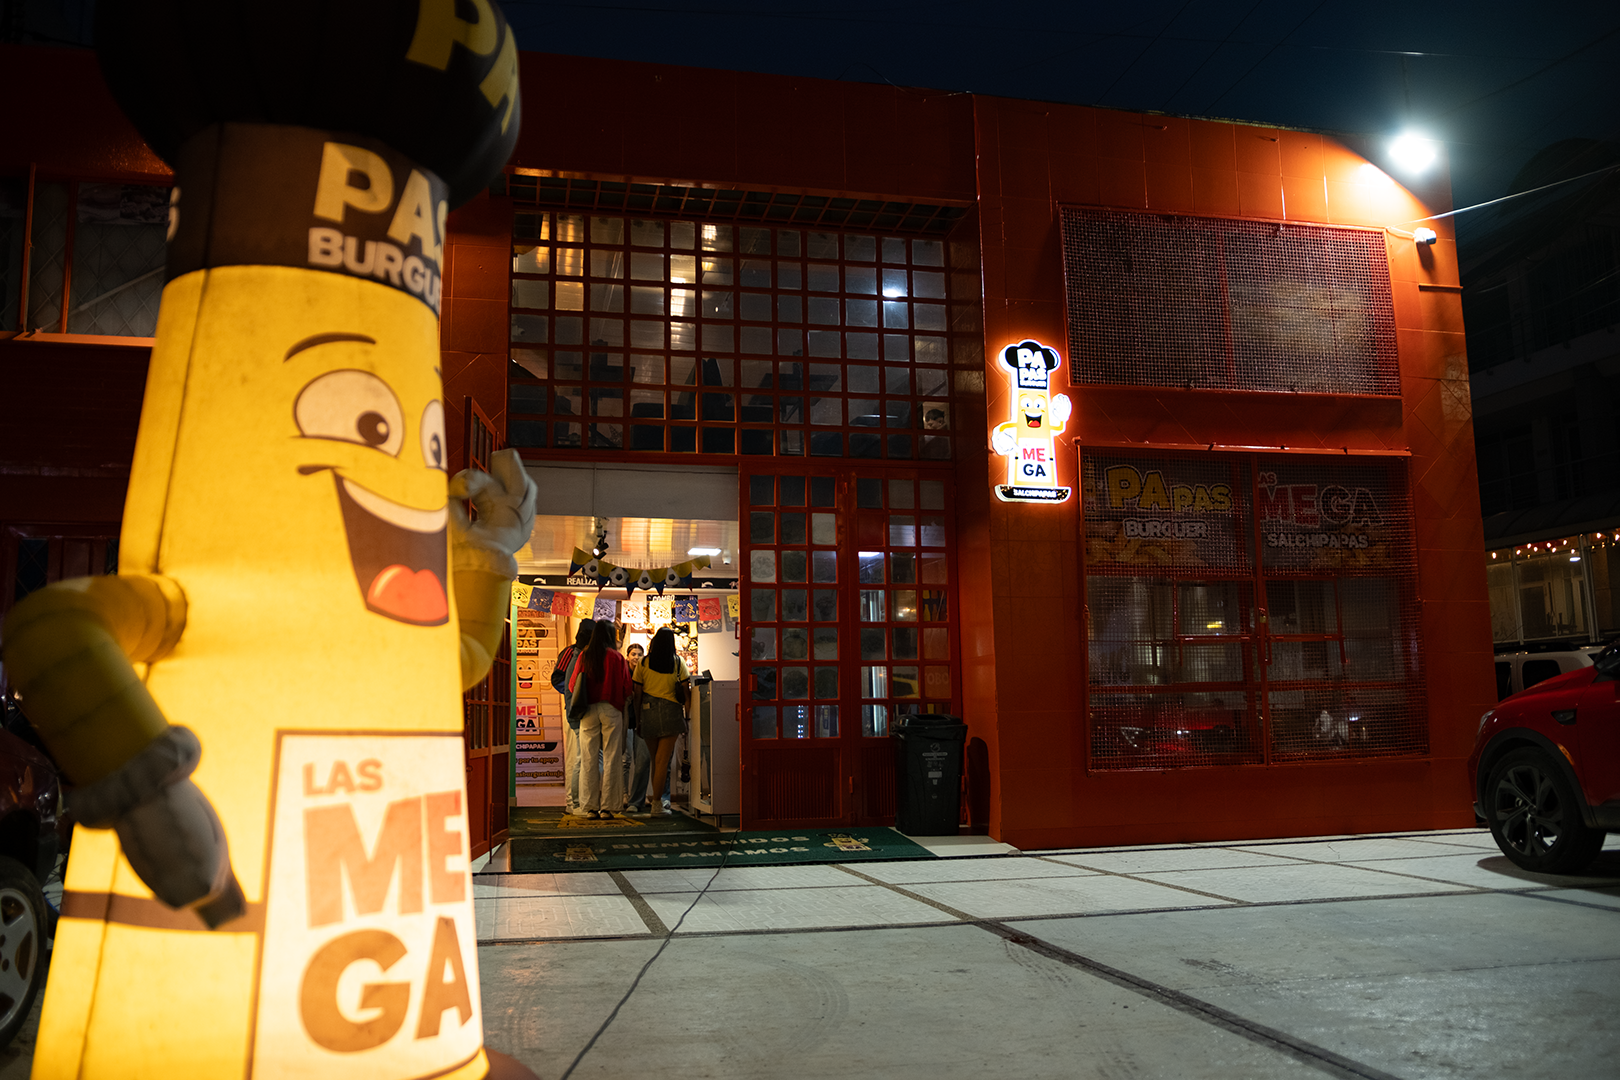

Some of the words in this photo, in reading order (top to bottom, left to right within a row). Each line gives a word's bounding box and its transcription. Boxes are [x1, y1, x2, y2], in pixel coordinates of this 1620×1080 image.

[1017, 349, 1046, 368] PA
[1023, 448, 1045, 462] ME
[1023, 464, 1046, 477] GA
[1258, 472, 1277, 485] AS
[1123, 519, 1209, 540] BURGUER
[1267, 532, 1370, 549] SALCHIPAPAS
[303, 759, 384, 797] LAS
[612, 835, 810, 850] BIENVENIDOS
[304, 790, 467, 929] ME
[631, 852, 669, 860] TE
[679, 846, 810, 859] AMAMOS
[299, 916, 473, 1056] GA
